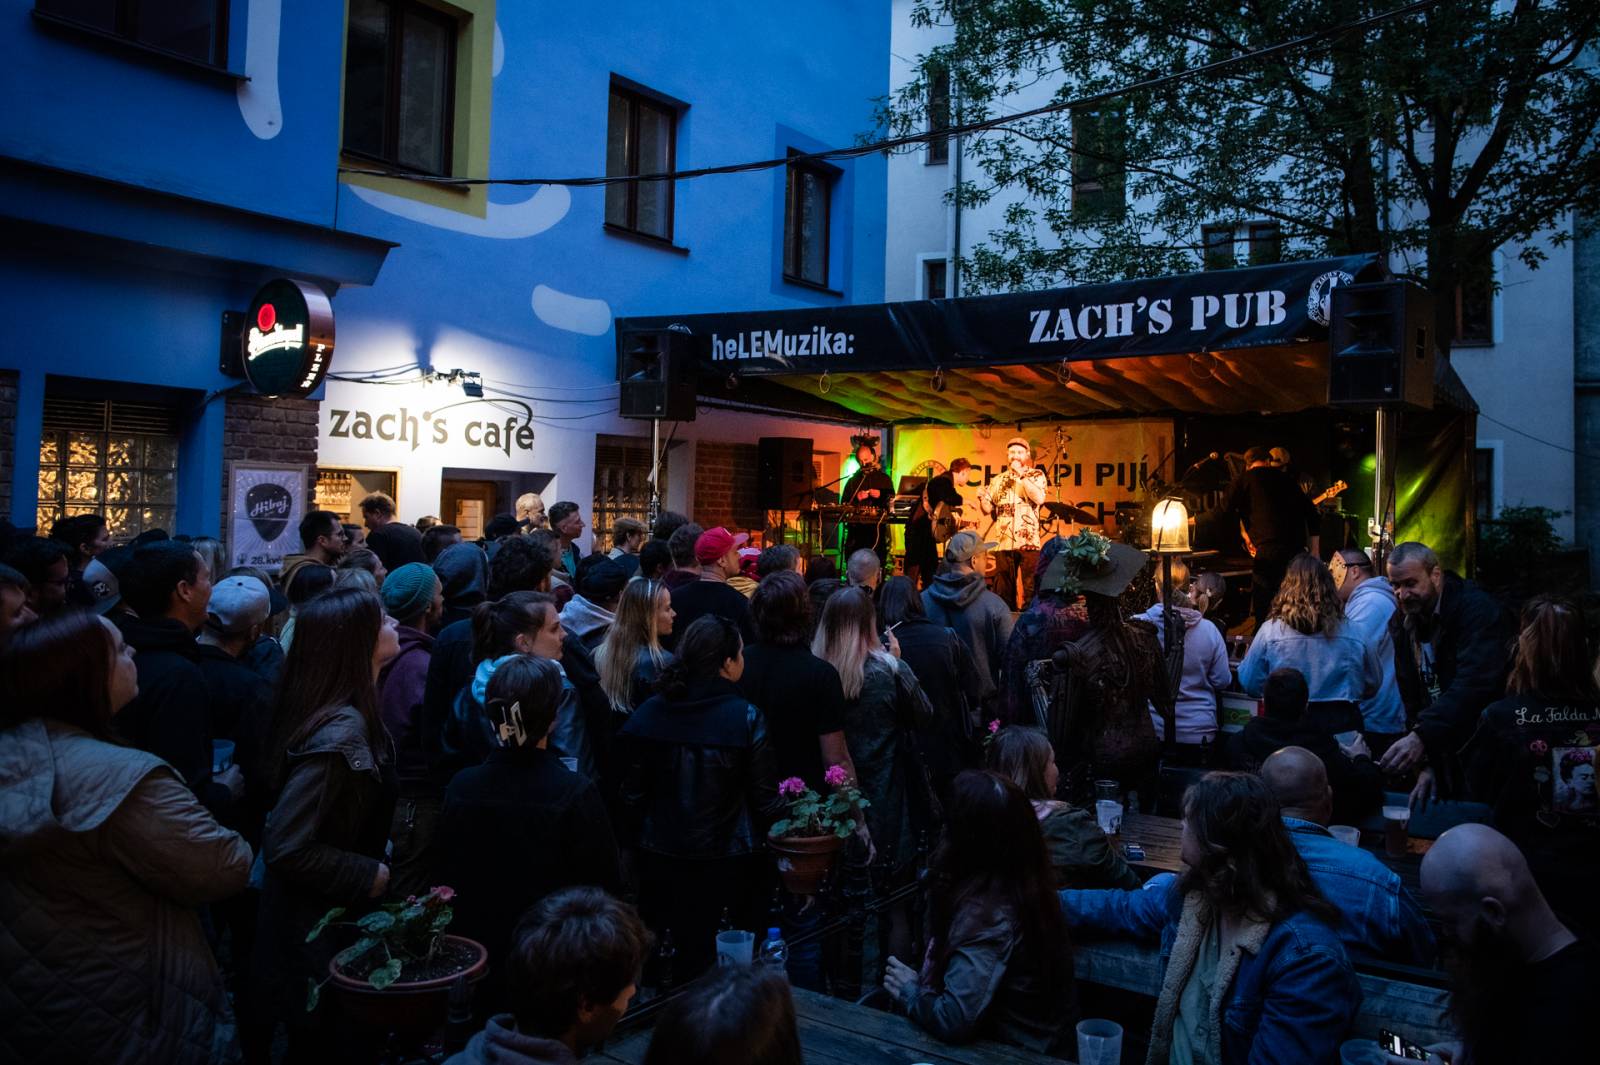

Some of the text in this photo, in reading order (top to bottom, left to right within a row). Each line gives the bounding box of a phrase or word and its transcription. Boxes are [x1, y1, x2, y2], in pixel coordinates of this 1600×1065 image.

[1029, 289, 1288, 343] ZACH'S PUB
[711, 325, 855, 361] heLEMuzika:
[329, 407, 448, 451] zach's
[1514, 706, 1543, 725] La
[1545, 705, 1590, 723] Falda
